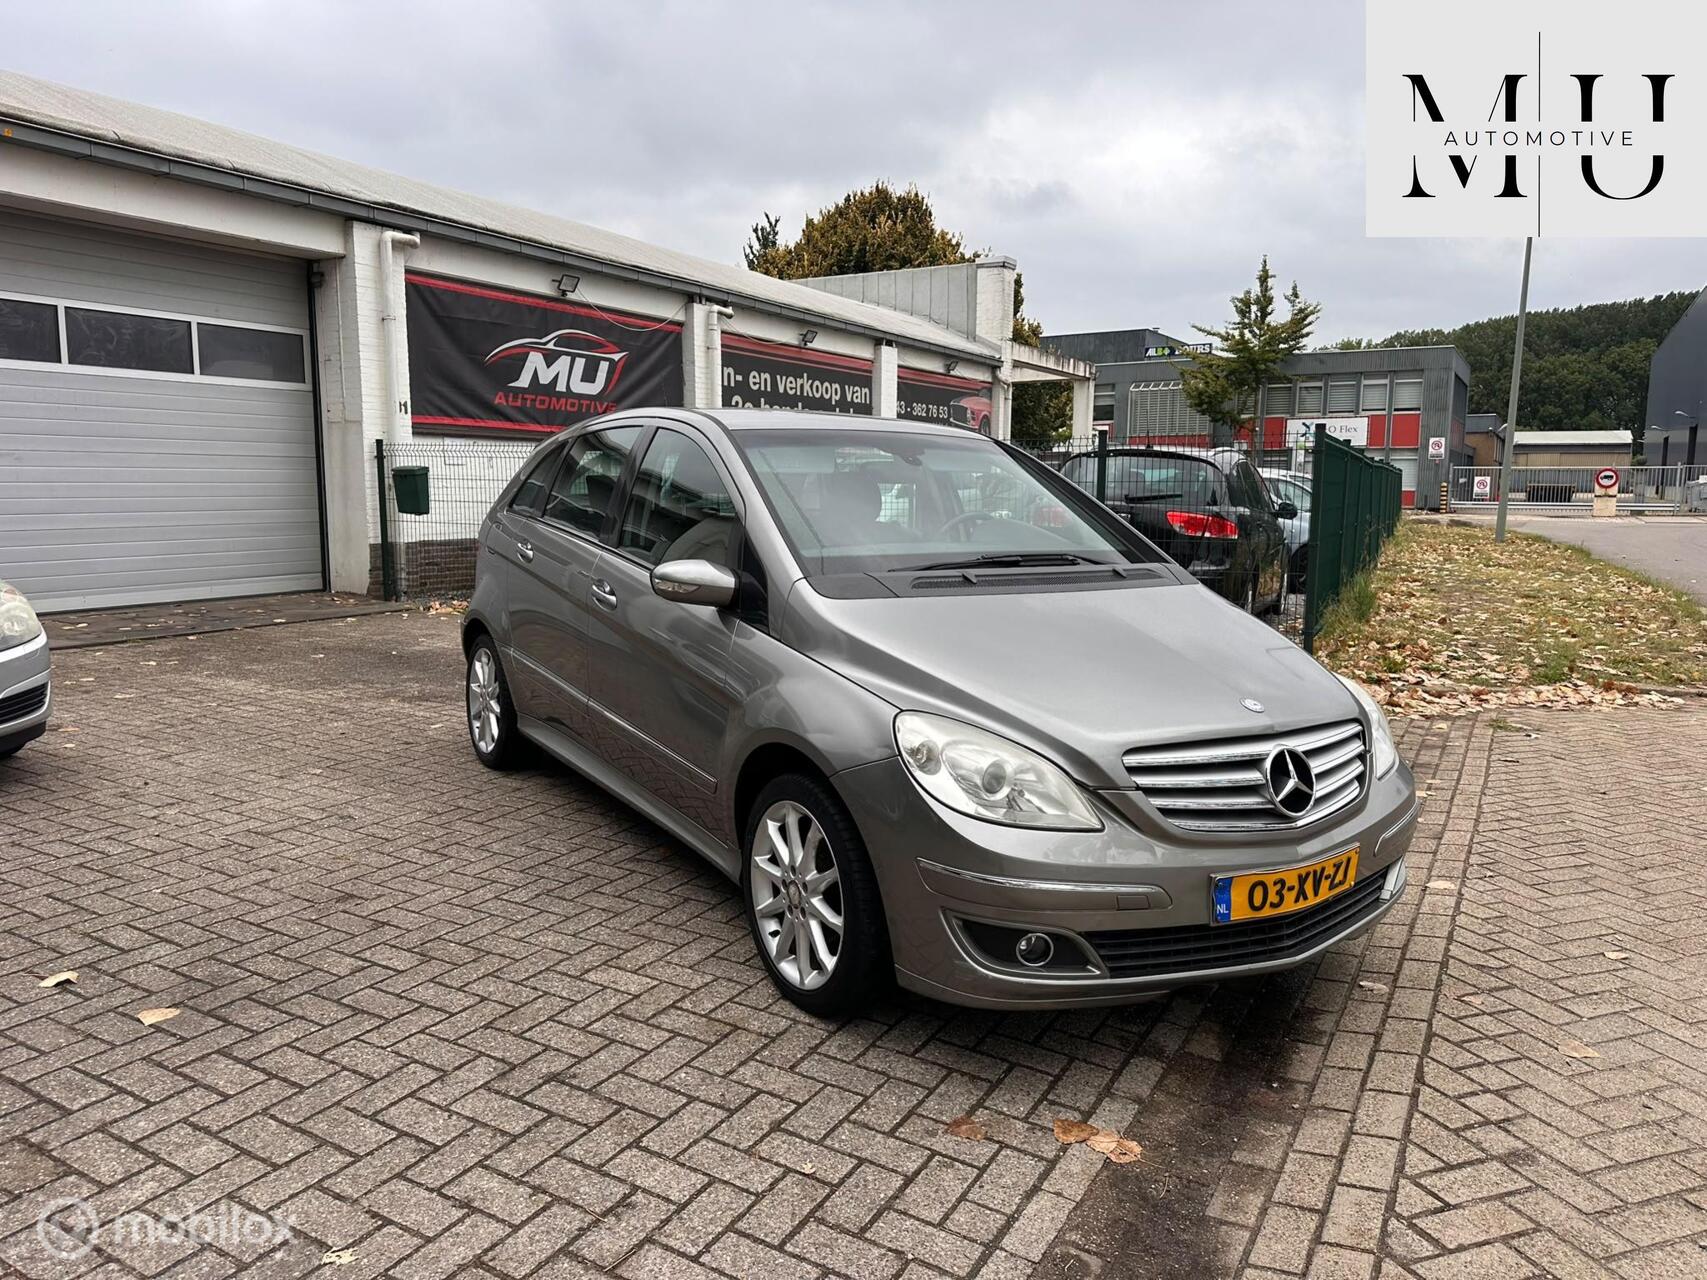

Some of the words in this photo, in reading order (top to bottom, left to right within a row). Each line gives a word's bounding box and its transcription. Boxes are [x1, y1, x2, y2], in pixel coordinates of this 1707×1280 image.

[507, 351, 610, 395] MU
[723, 366, 743, 387] n-
[749, 369, 772, 392] en
[777, 372, 841, 405] verkoop
[845, 385, 870, 404] van
[494, 391, 617, 414] AUTOMOTIVE
[912, 402, 927, 417] 362
[928, 404, 938, 418] 76
[938, 405, 948, 419] 53
[1340, 425, 1358, 433] Flex
[1247, 856, 1352, 912] 03-XV-ZJ
[1216, 904, 1229, 914] NL
